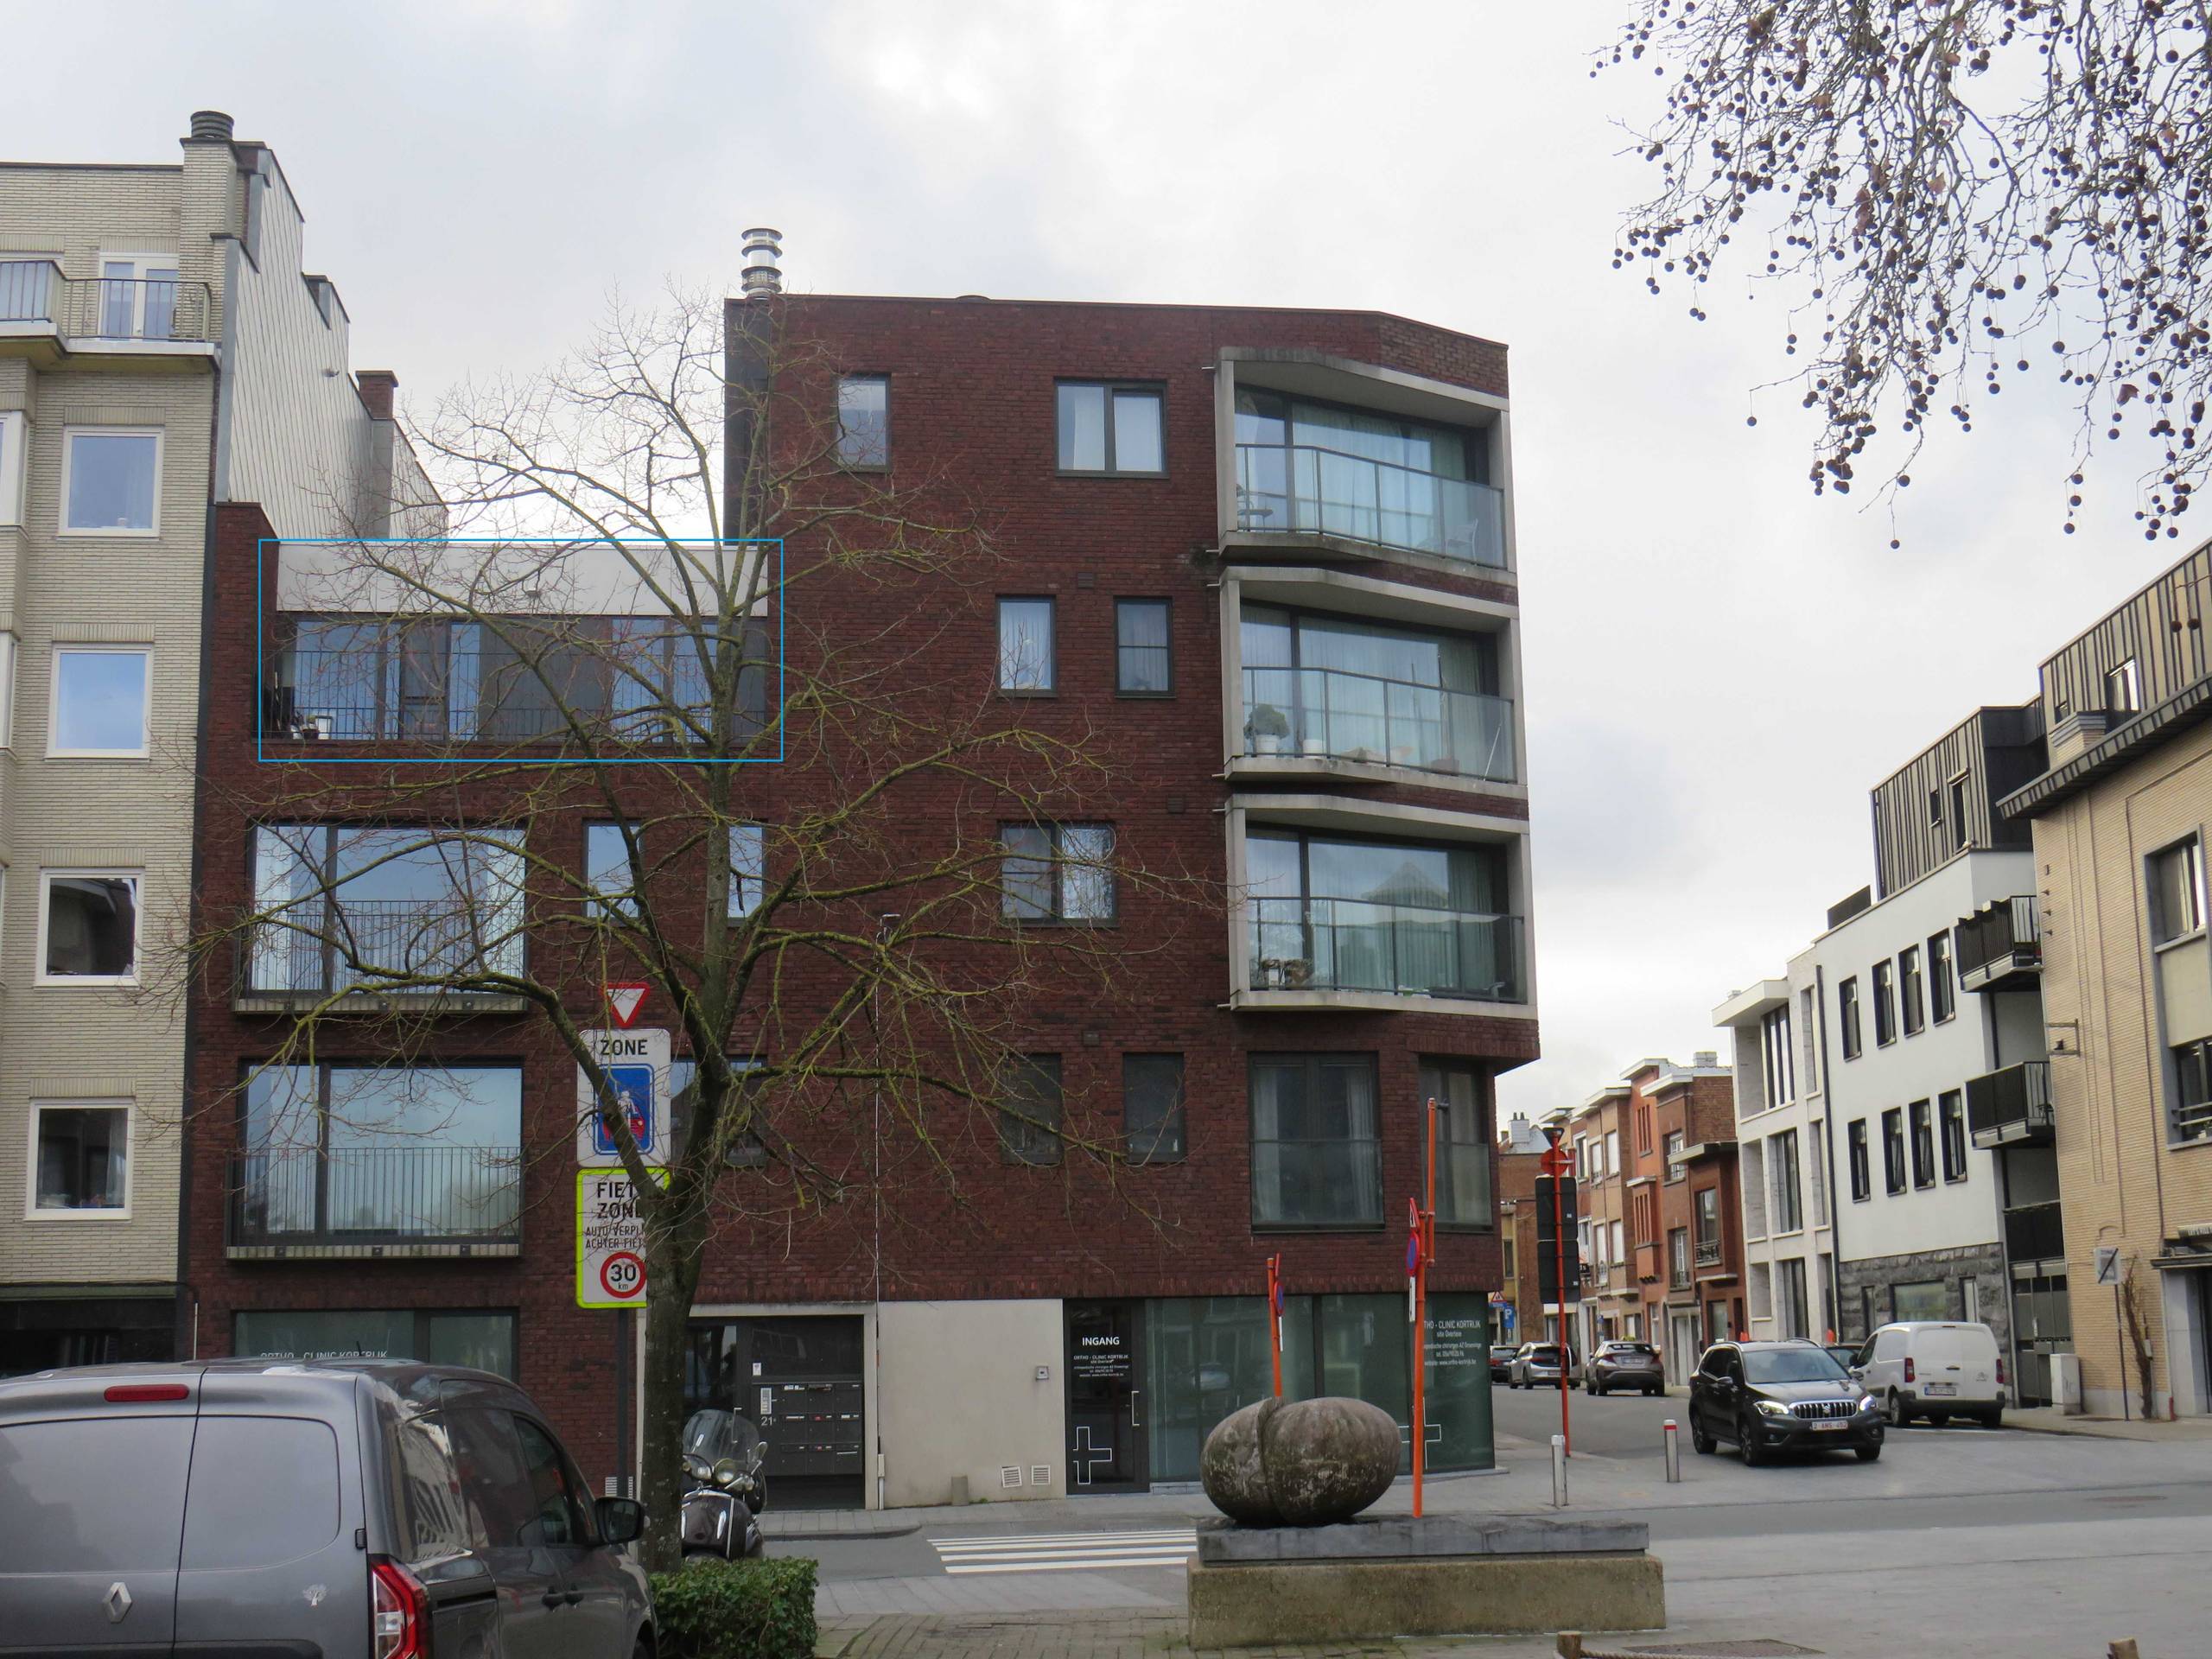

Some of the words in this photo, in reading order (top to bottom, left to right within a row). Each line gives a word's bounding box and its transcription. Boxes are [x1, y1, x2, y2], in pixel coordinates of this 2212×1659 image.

[601, 1039, 648, 1055] ZONE
[597, 1182, 635, 1198] FIET
[611, 1264, 637, 1282] 30
[1438, 1320, 1455, 1329] CLINIC
[1456, 1319, 1481, 1329] KORTRIJK
[1082, 1337, 1120, 1346] INGANG
[760, 1416, 772, 1426] 21
